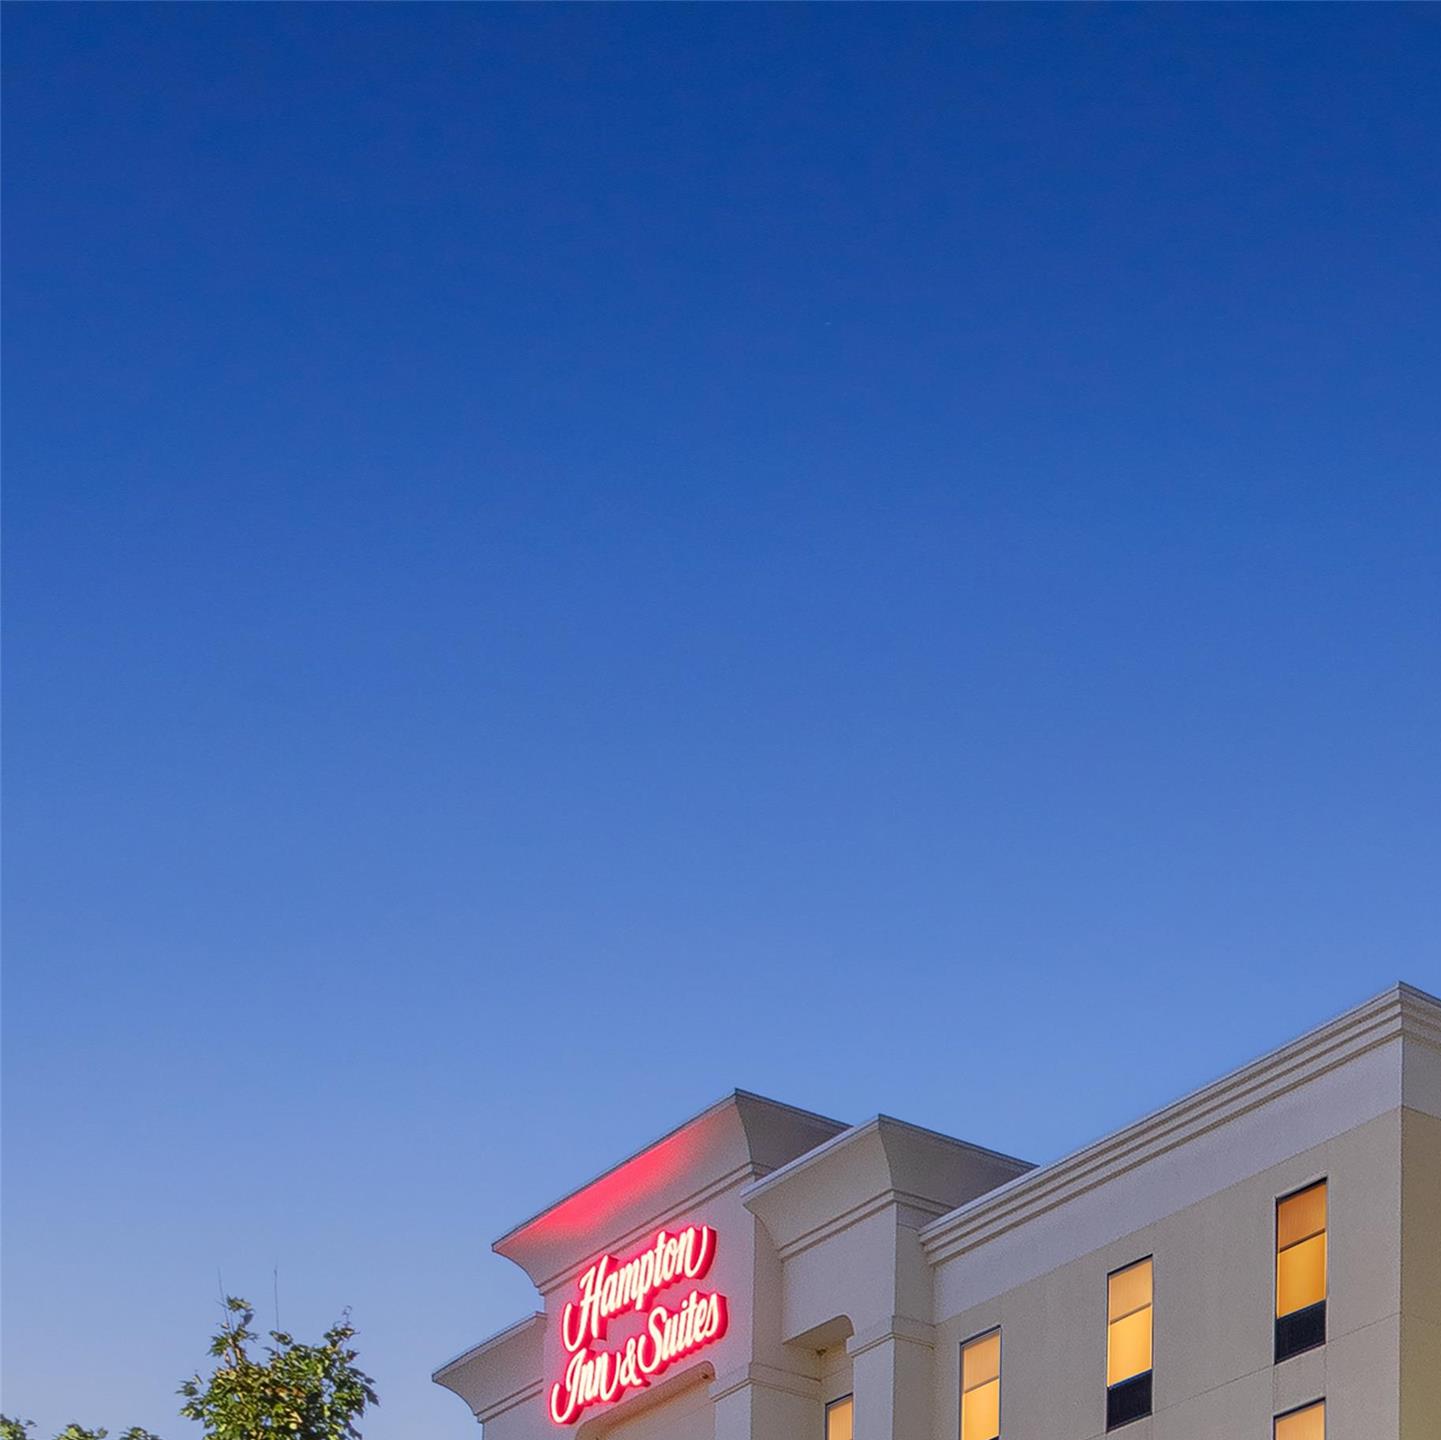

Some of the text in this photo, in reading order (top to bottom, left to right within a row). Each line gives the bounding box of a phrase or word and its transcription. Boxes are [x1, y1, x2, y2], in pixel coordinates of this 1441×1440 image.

[562, 1225, 709, 1352] Hampton
[550, 1290, 720, 1424] Inn & Suites
